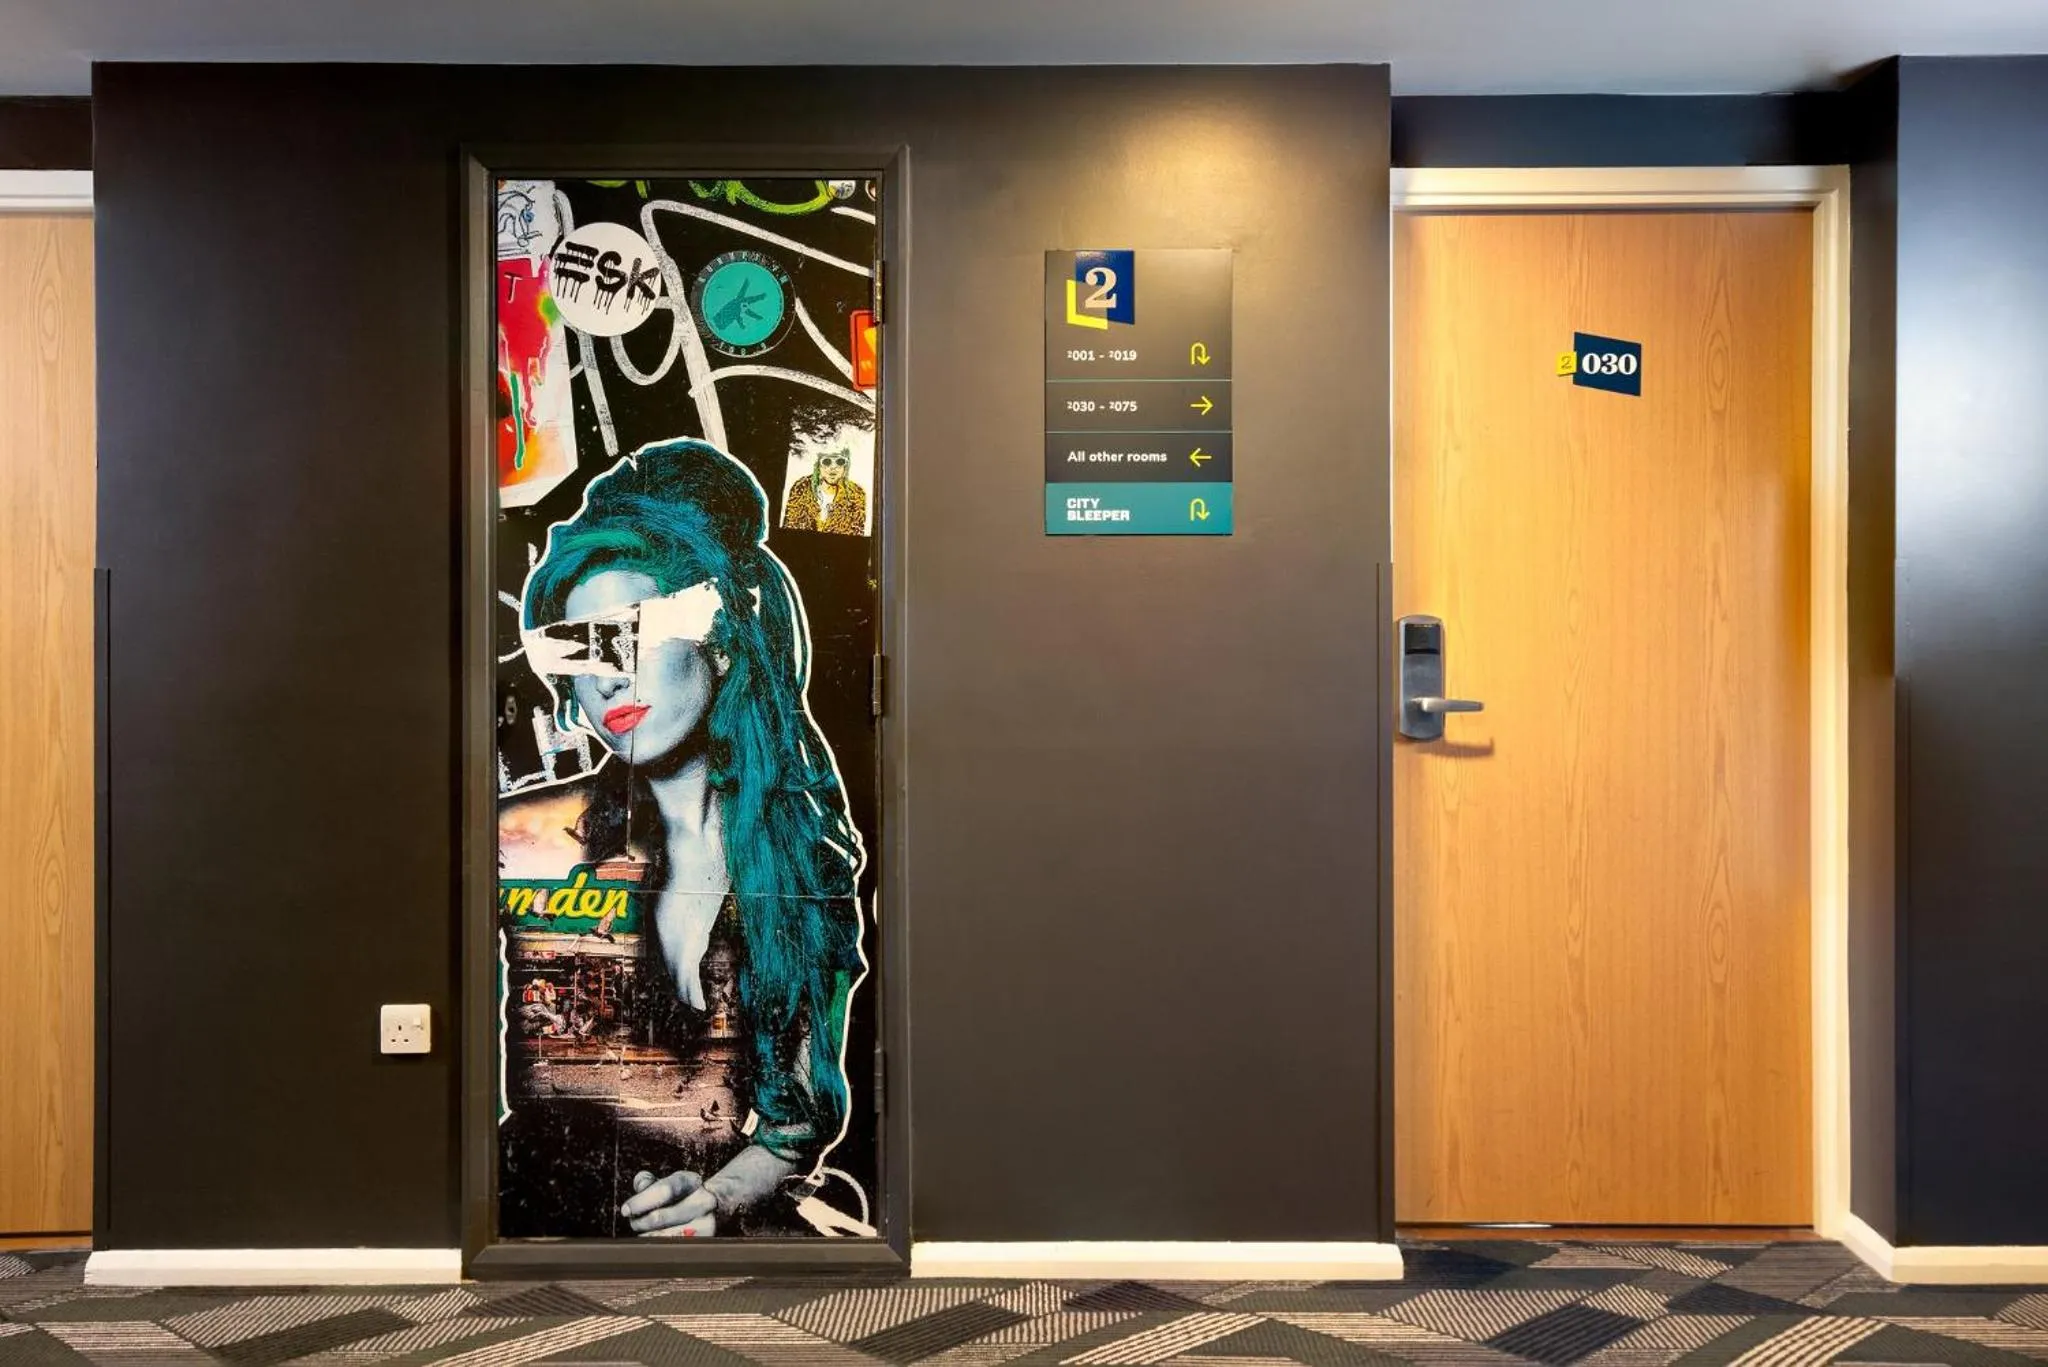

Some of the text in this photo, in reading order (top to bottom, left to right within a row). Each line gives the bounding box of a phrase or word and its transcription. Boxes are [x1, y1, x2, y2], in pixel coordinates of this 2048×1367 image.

[1084, 267, 1117, 309] 2
[1581, 353, 1638, 375] 030
[1067, 450, 1168, 462] All other rooms
[1066, 497, 1100, 509] CITY
